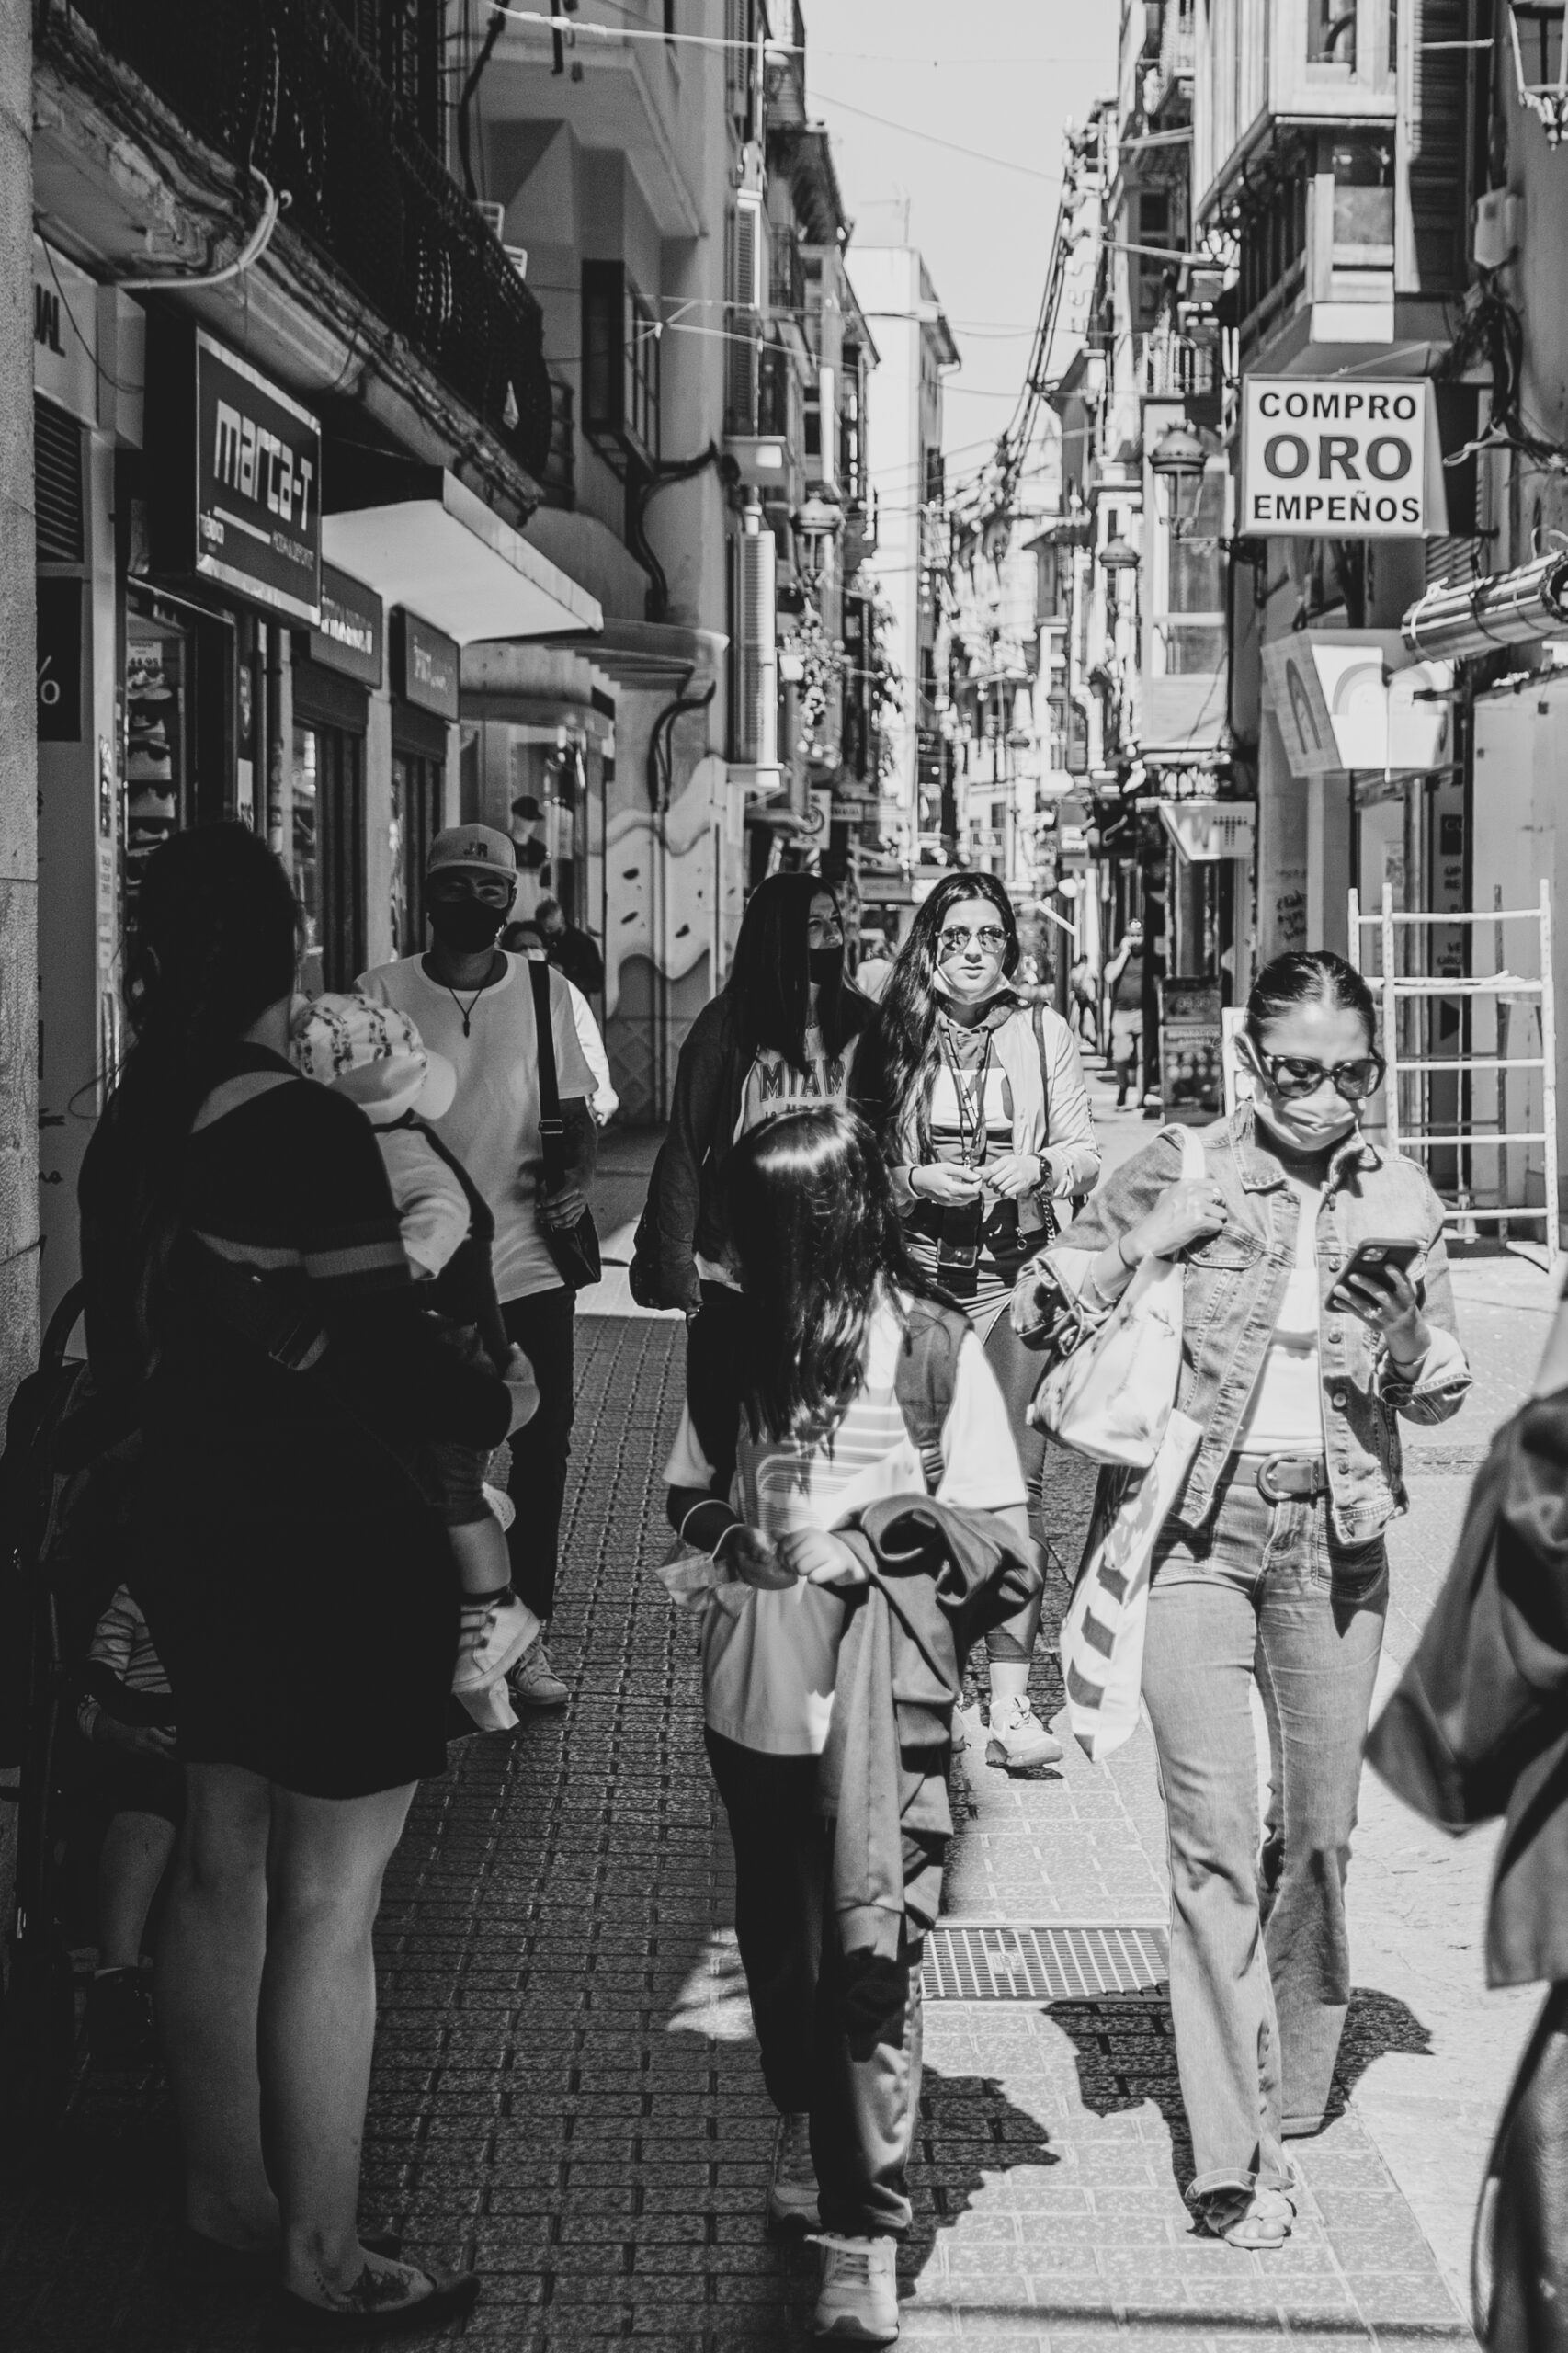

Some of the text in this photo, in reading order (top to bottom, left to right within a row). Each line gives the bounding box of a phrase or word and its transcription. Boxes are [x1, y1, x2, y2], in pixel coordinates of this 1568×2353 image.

[1259, 392, 1416, 420] COMPRO
[1264, 434, 1412, 481] ORO
[1253, 490, 1420, 523] EMPEÑOS
